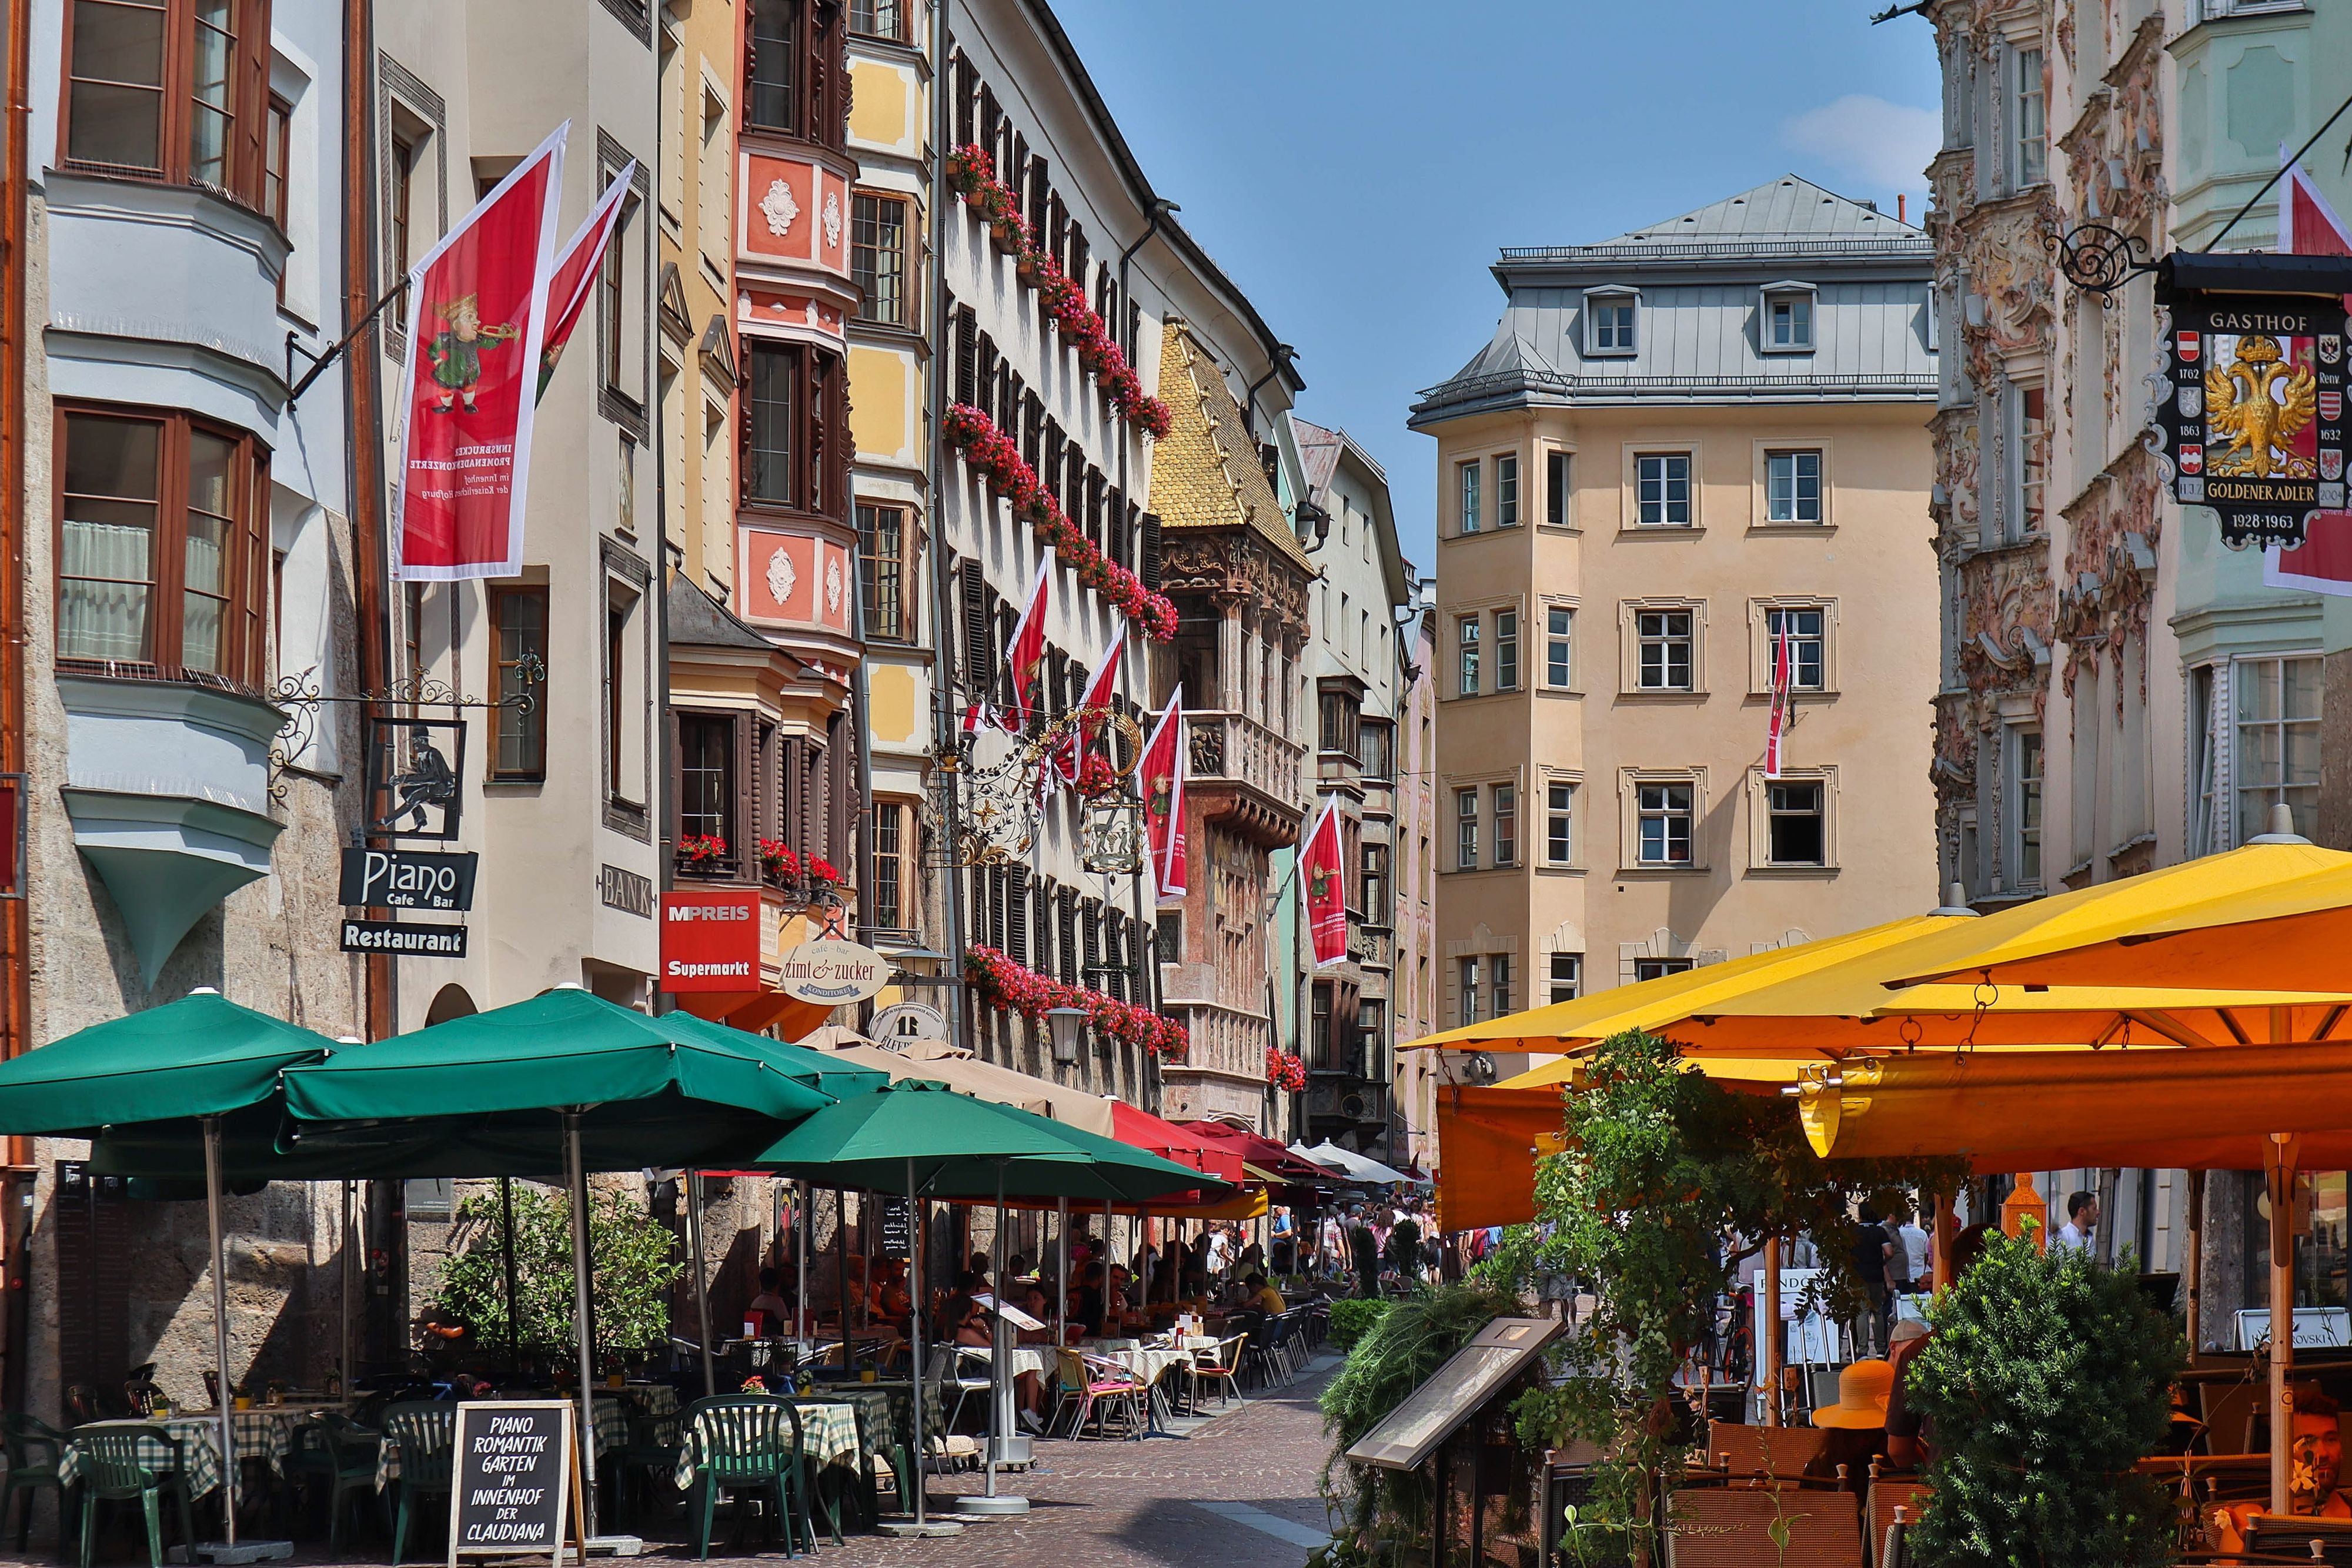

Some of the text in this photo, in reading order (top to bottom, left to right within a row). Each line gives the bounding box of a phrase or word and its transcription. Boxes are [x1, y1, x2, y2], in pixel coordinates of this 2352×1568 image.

[2210, 312, 2307, 332] GASTHOF
[2179, 369, 2199, 379] 1762
[2180, 426, 2200, 436] 1863
[2321, 430, 2341, 440] 1632
[2208, 483, 2314, 501] GOLDENER ADLER
[2320, 489, 2343, 501] 2004
[361, 852, 456, 904] Piano
[386, 893, 454, 908] Cafe Bar
[604, 868, 650, 917] BANK
[669, 905, 750, 921] MPREIS
[345, 925, 461, 951] Restaurant
[811, 944, 828, 954] café
[836, 945, 850, 955] bar
[668, 961, 749, 978] Supermarkt
[785, 958, 875, 981] zimt & zucker
[807, 985, 851, 997] KONDITOREI
[490, 1417, 533, 1435] PIANO
[473, 1436, 548, 1455] ROMANTIK
[482, 1455, 537, 1474] GARTEN
[502, 1475, 516, 1487] IM
[471, 1488, 545, 1506] INNENHOF
[496, 1507, 518, 1520] DER
[467, 1523, 545, 1542] CLAUDIANA
